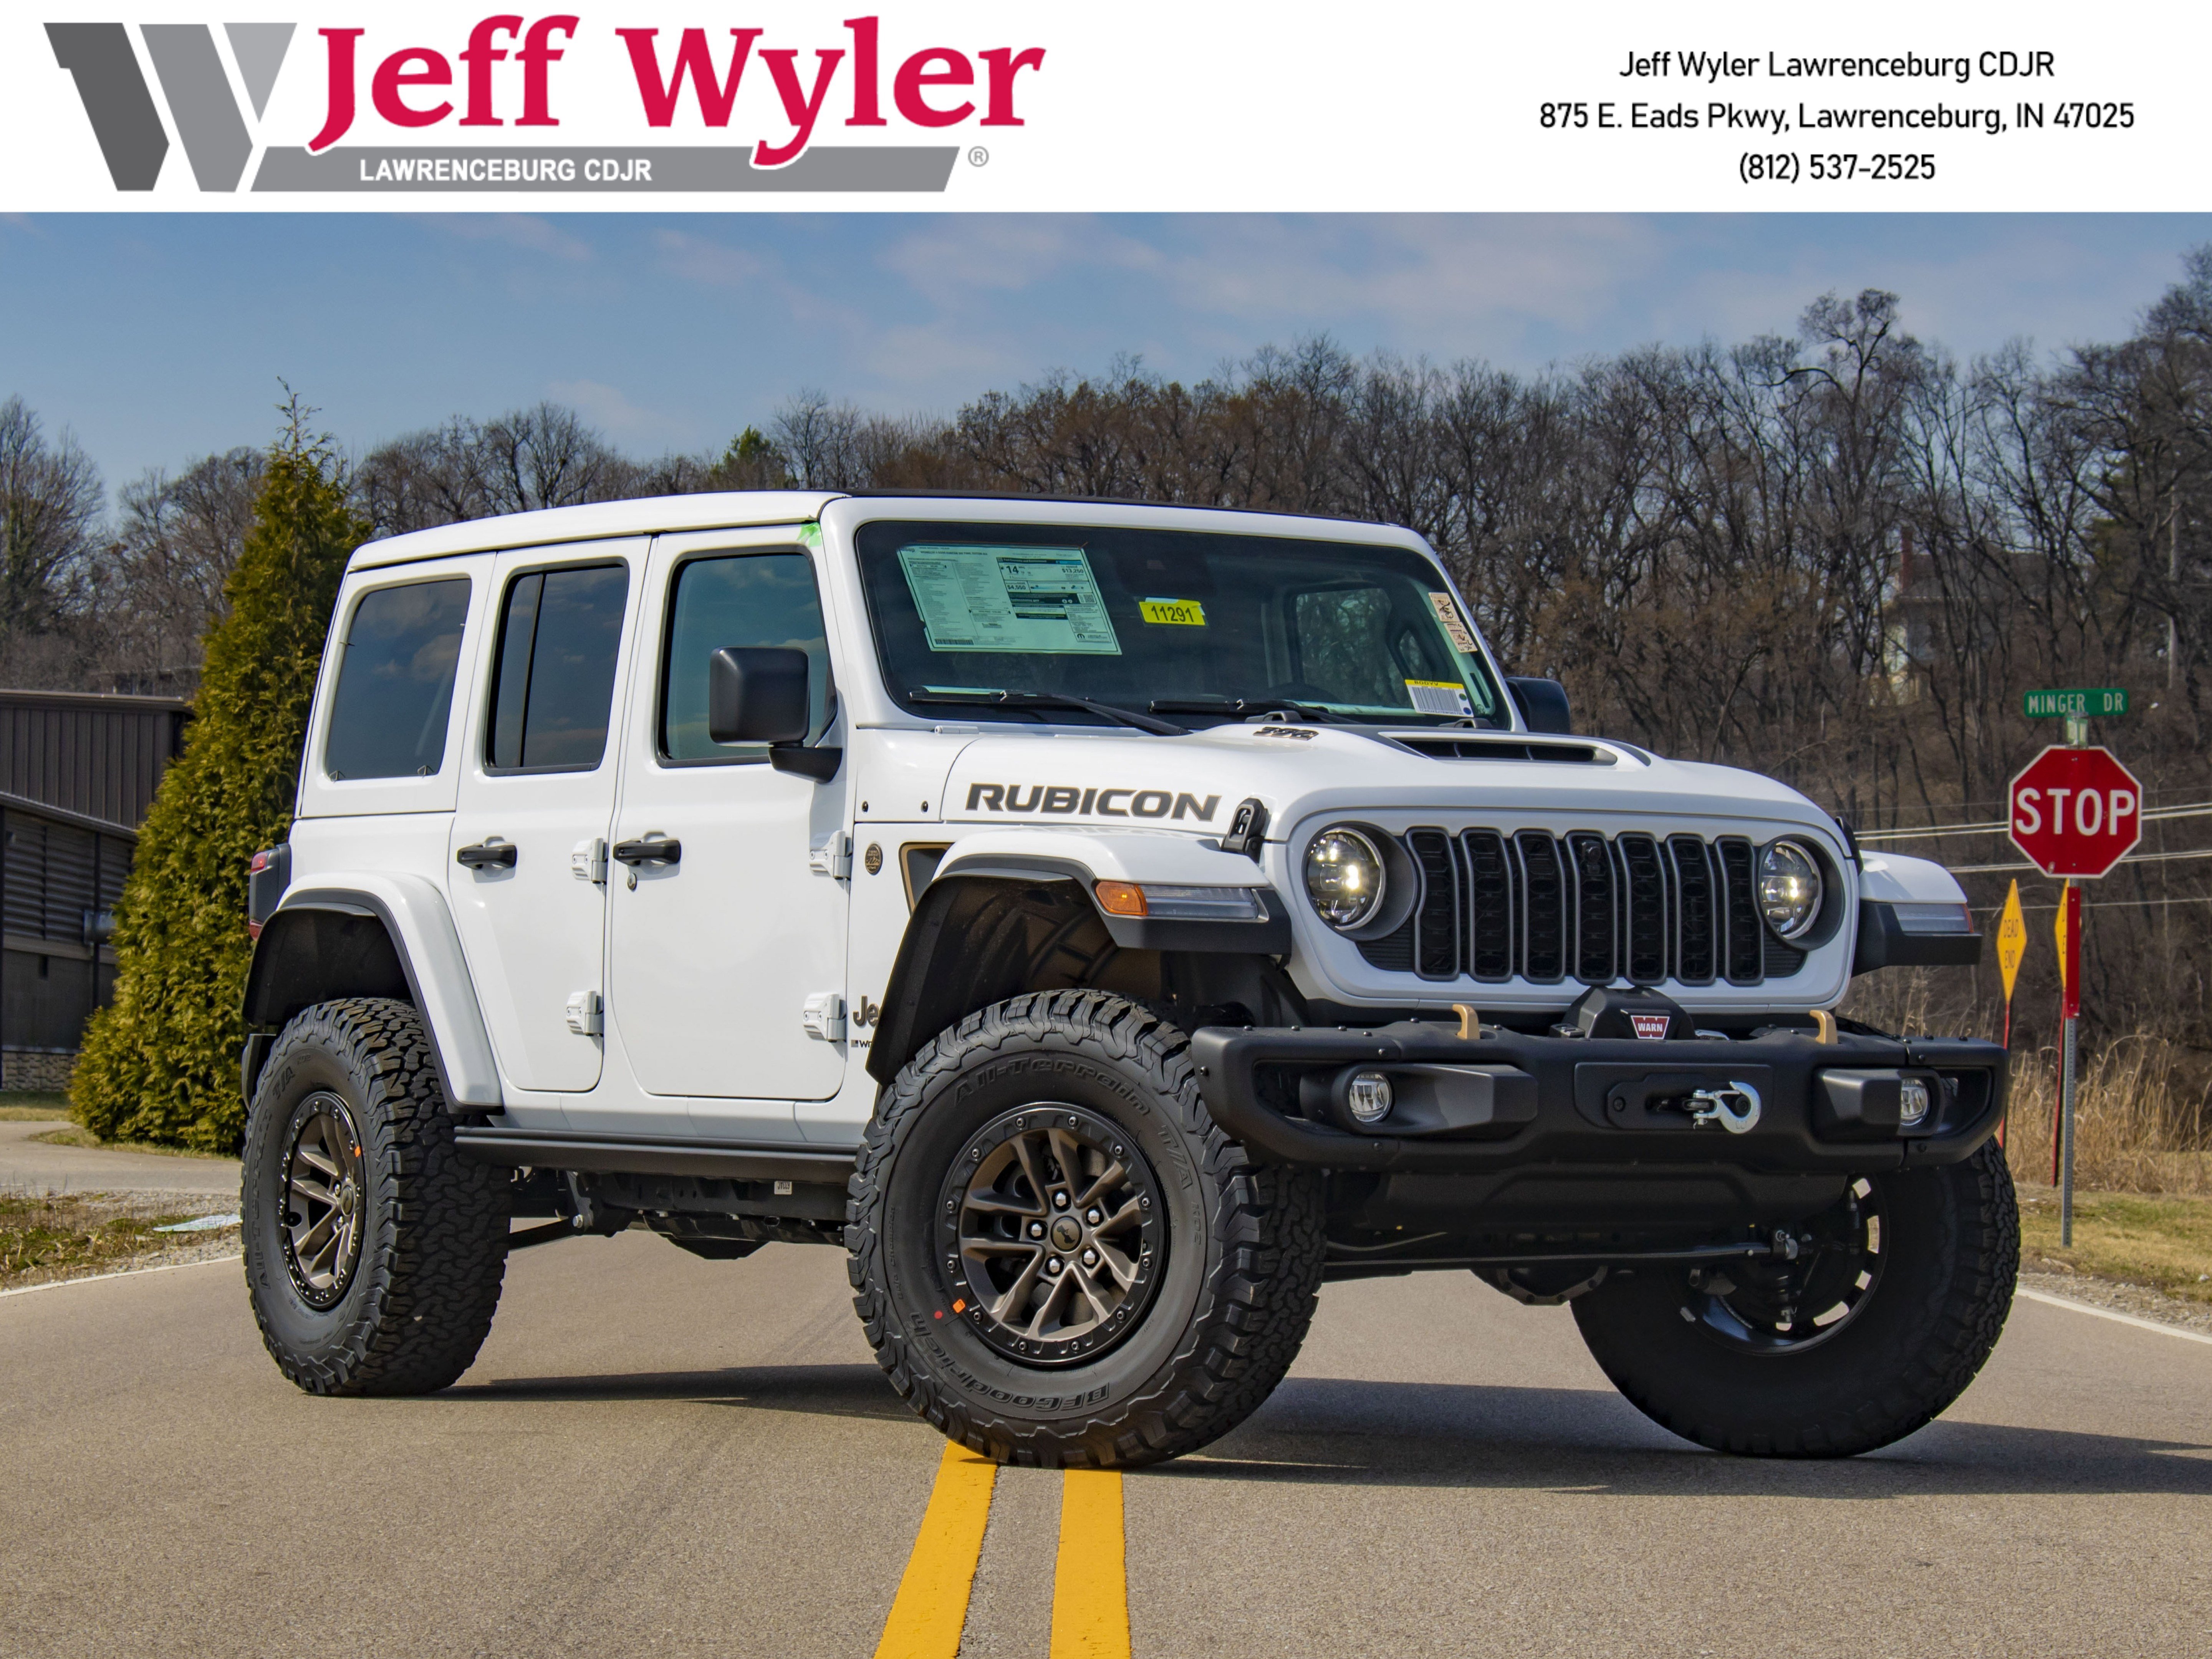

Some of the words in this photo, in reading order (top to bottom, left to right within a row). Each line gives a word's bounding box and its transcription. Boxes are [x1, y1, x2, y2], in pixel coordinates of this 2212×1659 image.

[1006, 566, 1019, 574] 14
[1151, 605, 1194, 623] 11291
[2028, 693, 2085, 714] MINGER
[2103, 692, 2124, 712] DR
[965, 783, 1223, 823] RUBICON
[2015, 787, 2136, 836] STOP
[2003, 919, 2018, 938] DEAD
[2004, 950, 2016, 969] END
[1638, 1023, 1663, 1032] WARN
[955, 1057, 1151, 1116] All-Terrain
[1158, 1124, 1193, 1190] T/A
[909, 1312, 1109, 1412] BFGoodrich
